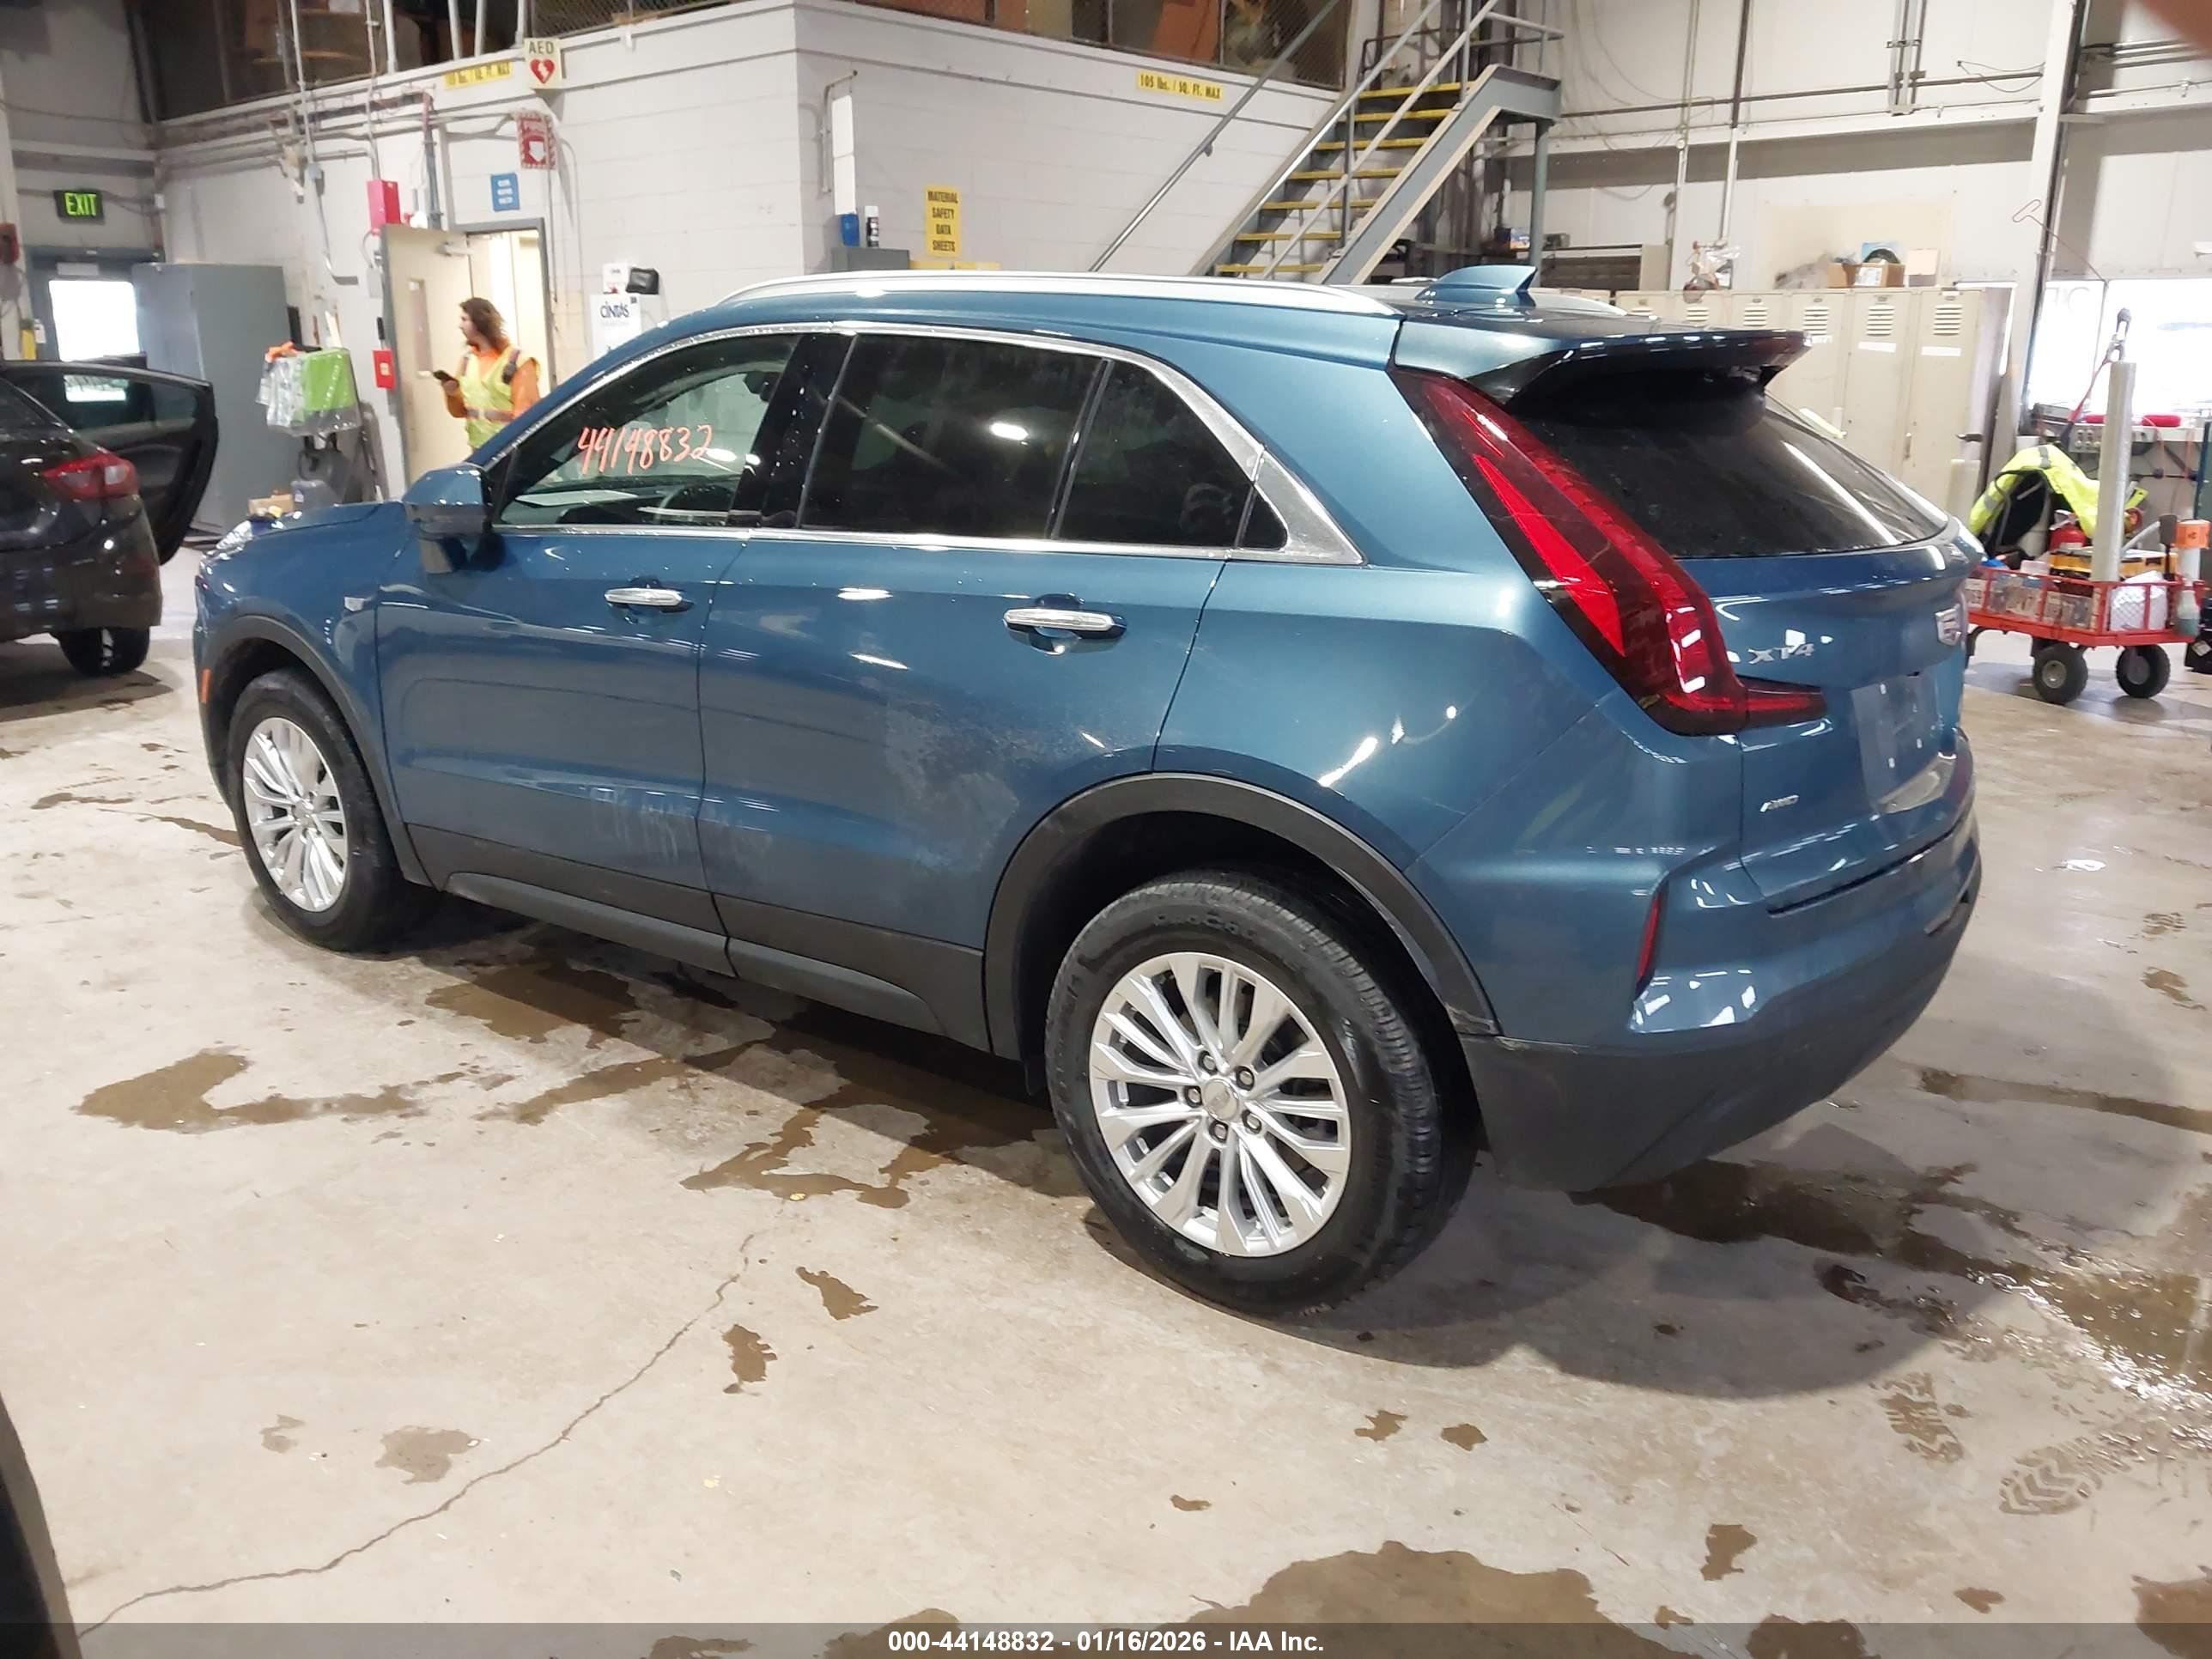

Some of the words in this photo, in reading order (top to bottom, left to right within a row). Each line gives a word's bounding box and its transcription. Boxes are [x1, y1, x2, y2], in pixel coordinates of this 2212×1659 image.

[529, 40, 554, 55] AED
[1206, 86, 1220, 100] MAX
[64, 192, 97, 216] EXIT
[927, 191, 958, 204] MATERIAL
[933, 207, 955, 220] SAFETY
[936, 224, 951, 235] DATA
[933, 240, 956, 252] SHEETS
[578, 424, 713, 475] 44148832
[1747, 642, 1814, 665] XT4
